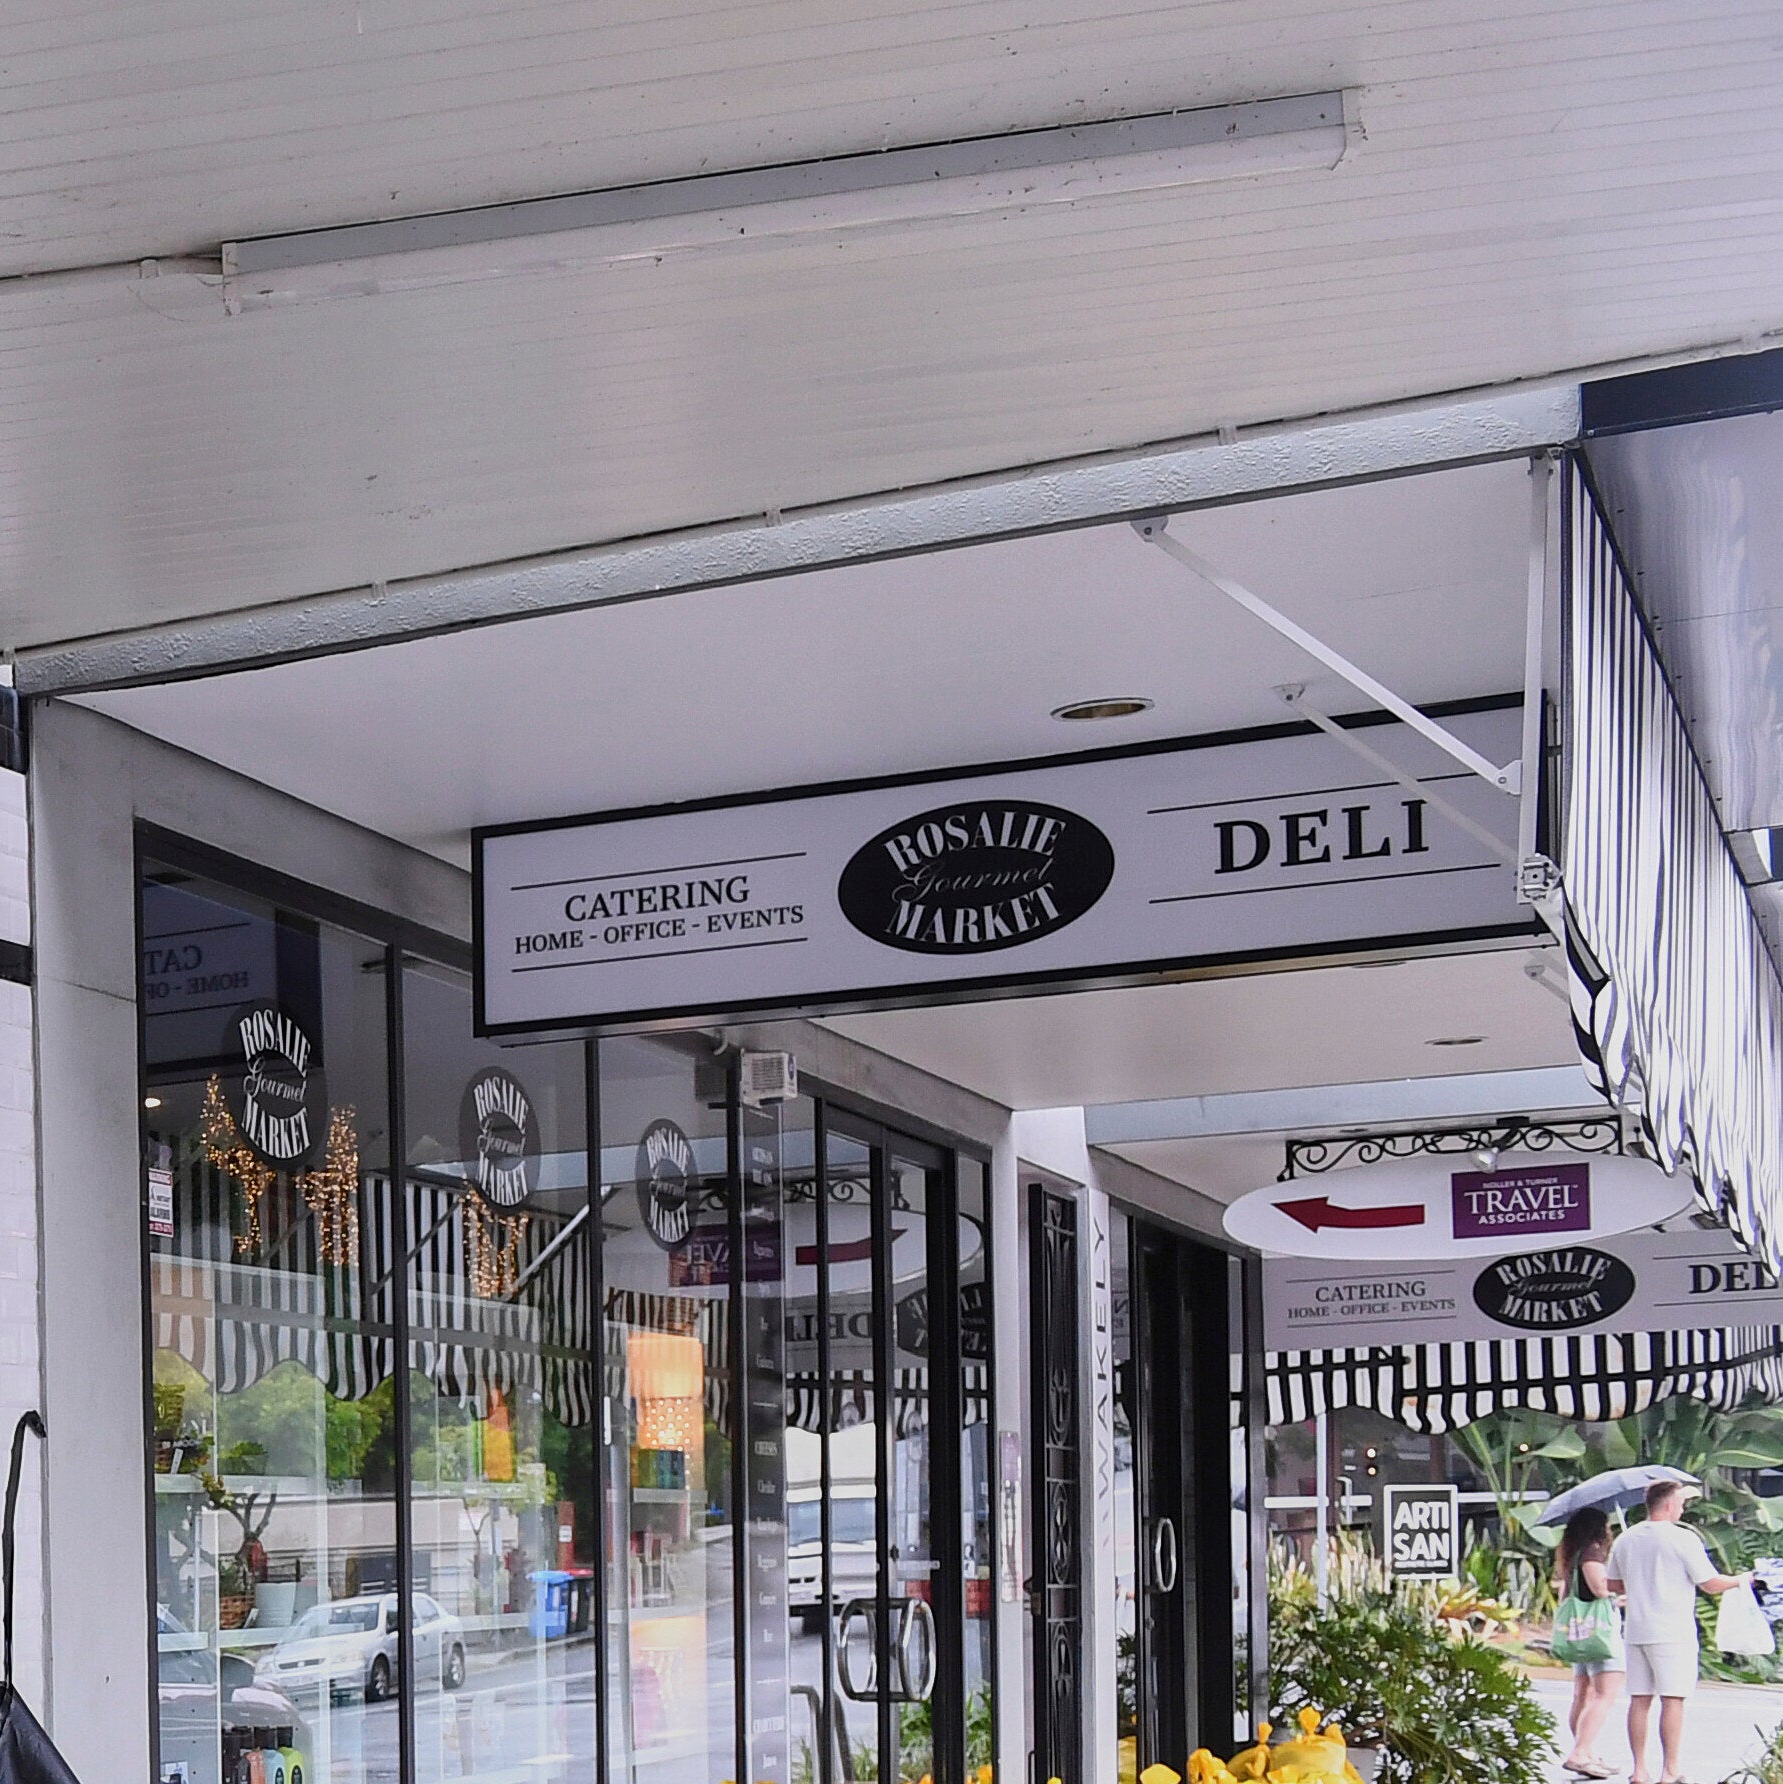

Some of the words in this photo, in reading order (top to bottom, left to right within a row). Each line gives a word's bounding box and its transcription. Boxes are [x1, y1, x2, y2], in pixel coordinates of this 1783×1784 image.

[883, 811, 1067, 872] ROSALIE
[1214, 800, 1430, 875] DELI
[564, 875, 751, 922] CATERING
[891, 857, 1054, 904] Gourmet
[514, 930, 584, 955] HOME
[603, 919, 687, 945] OFFICE
[706, 905, 805, 934] EVENTS
[885, 881, 1065, 944] MARKET
[239, 1008, 311, 1078] ROSALIE
[243, 1056, 306, 1102] Gourmet
[241, 1095, 311, 1159] MARKET
[473, 1076, 529, 1135] ROSALIE
[476, 1150, 529, 1206] MARKET
[1463, 1185, 1575, 1215] TRAVEL
[1478, 1209, 1566, 1225] ASSOCIATES
[1494, 1251, 1611, 1283] ROSALIE
[1689, 1260, 1781, 1296] DEL
[1287, 1306, 1329, 1320] HOME
[1340, 1303, 1391, 1317] OFFICE
[1396, 1297, 1456, 1312] EVENTS
[1314, 1281, 1426, 1303] CATERING
[1499, 1291, 1606, 1325] MARKET
[1393, 1501, 1450, 1530] ARTI
[1393, 1532, 1450, 1561] SAN
